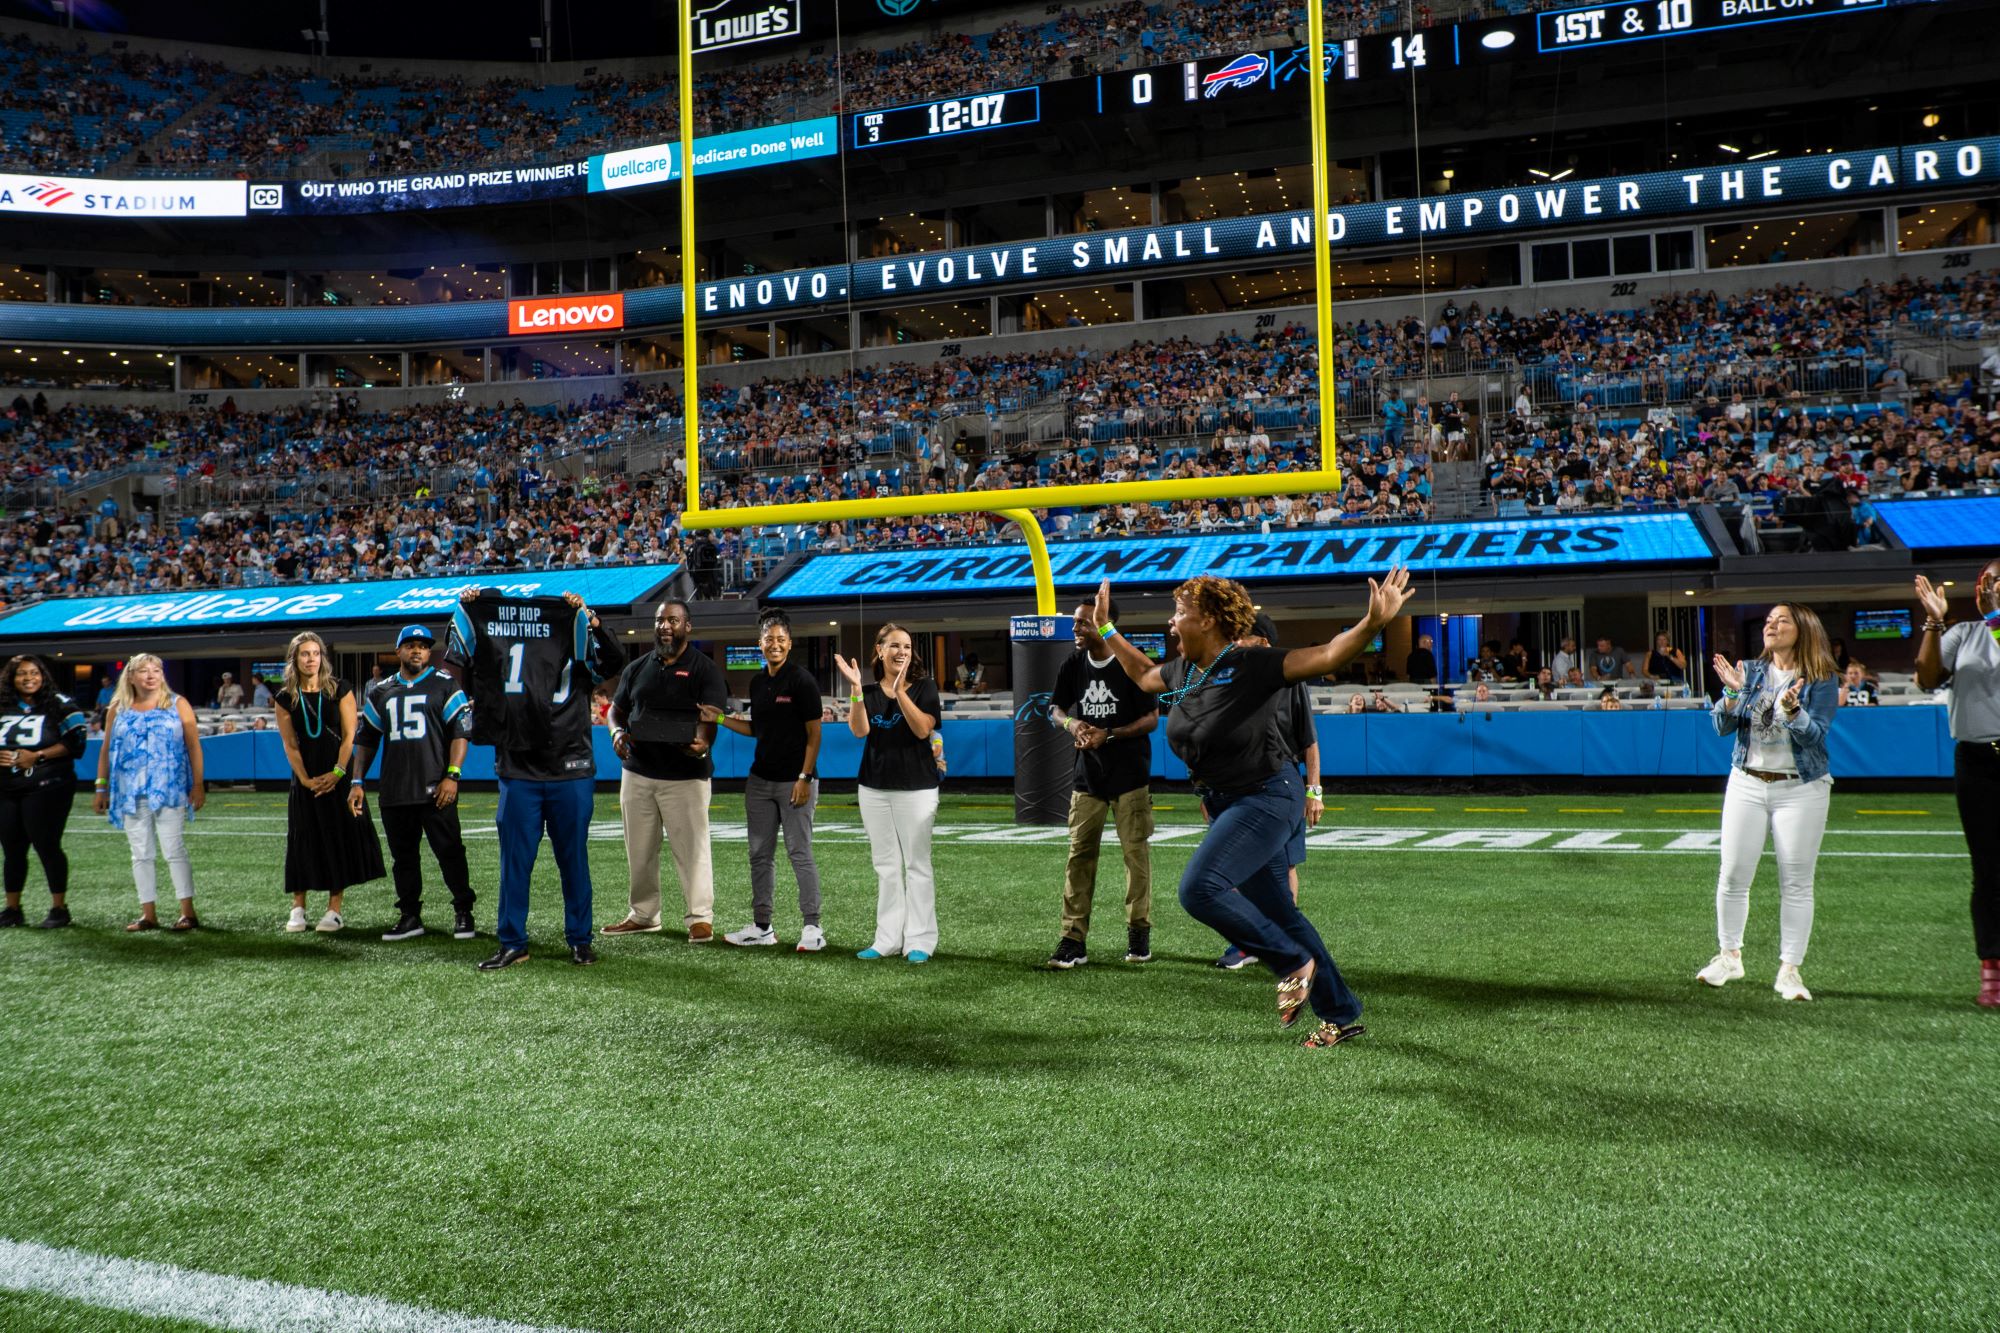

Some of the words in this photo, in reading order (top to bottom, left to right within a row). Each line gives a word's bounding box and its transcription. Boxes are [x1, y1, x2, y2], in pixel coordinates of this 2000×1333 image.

[1722, 0, 1776, 16] BALL
[700, 5, 789, 45] LOWE'S
[1555, 10, 1605, 43] 1ST
[1622, 8, 1645, 33] &
[1657, 0, 1693, 31] 10
[1391, 33, 1426, 70] 14
[1132, 73, 1151, 104] 0
[864, 114, 883, 126] QTR
[928, 94, 1005, 134] 12:07
[751, 140, 787, 156] Done
[790, 132, 824, 150] Well
[869, 127, 879, 142] 3
[608, 157, 667, 179] wellcare
[338, 182, 374, 197] WHO
[378, 178, 407, 193] THE
[411, 173, 465, 191] GRAND
[469, 171, 513, 186] PRIZE
[516, 164, 574, 182] WINNER
[84, 194, 196, 210] STADIUM
[254, 190, 279, 205] CC
[680, 273, 847, 315] ENOVO.
[882, 247, 1038, 290] EVOLVE
[1072, 227, 1220, 268] SMALL
[1256, 213, 1346, 248] AND
[1386, 182, 1641, 235] EMPOWER
[1682, 166, 1783, 204] THE
[1828, 145, 1982, 190] CARO
[1611, 282, 1637, 297] 202
[519, 305, 614, 327] Lenovo
[1255, 314, 1275, 328] 201
[876, 486, 889, 496] 59
[1206, 526, 1625, 569] PANTHERS
[64, 593, 343, 626] wellcare
[375, 599, 456, 611] Done
[498, 606, 516, 621] HIP
[519, 607, 541, 621] HOP
[487, 622, 550, 637] SMOOTHIES
[504, 643, 525, 693] 1
[1847, 690, 1870, 706] 59
[386, 694, 427, 741] 15
[1082, 702, 1117, 718] Kappa
[0, 715, 45, 746] 79
